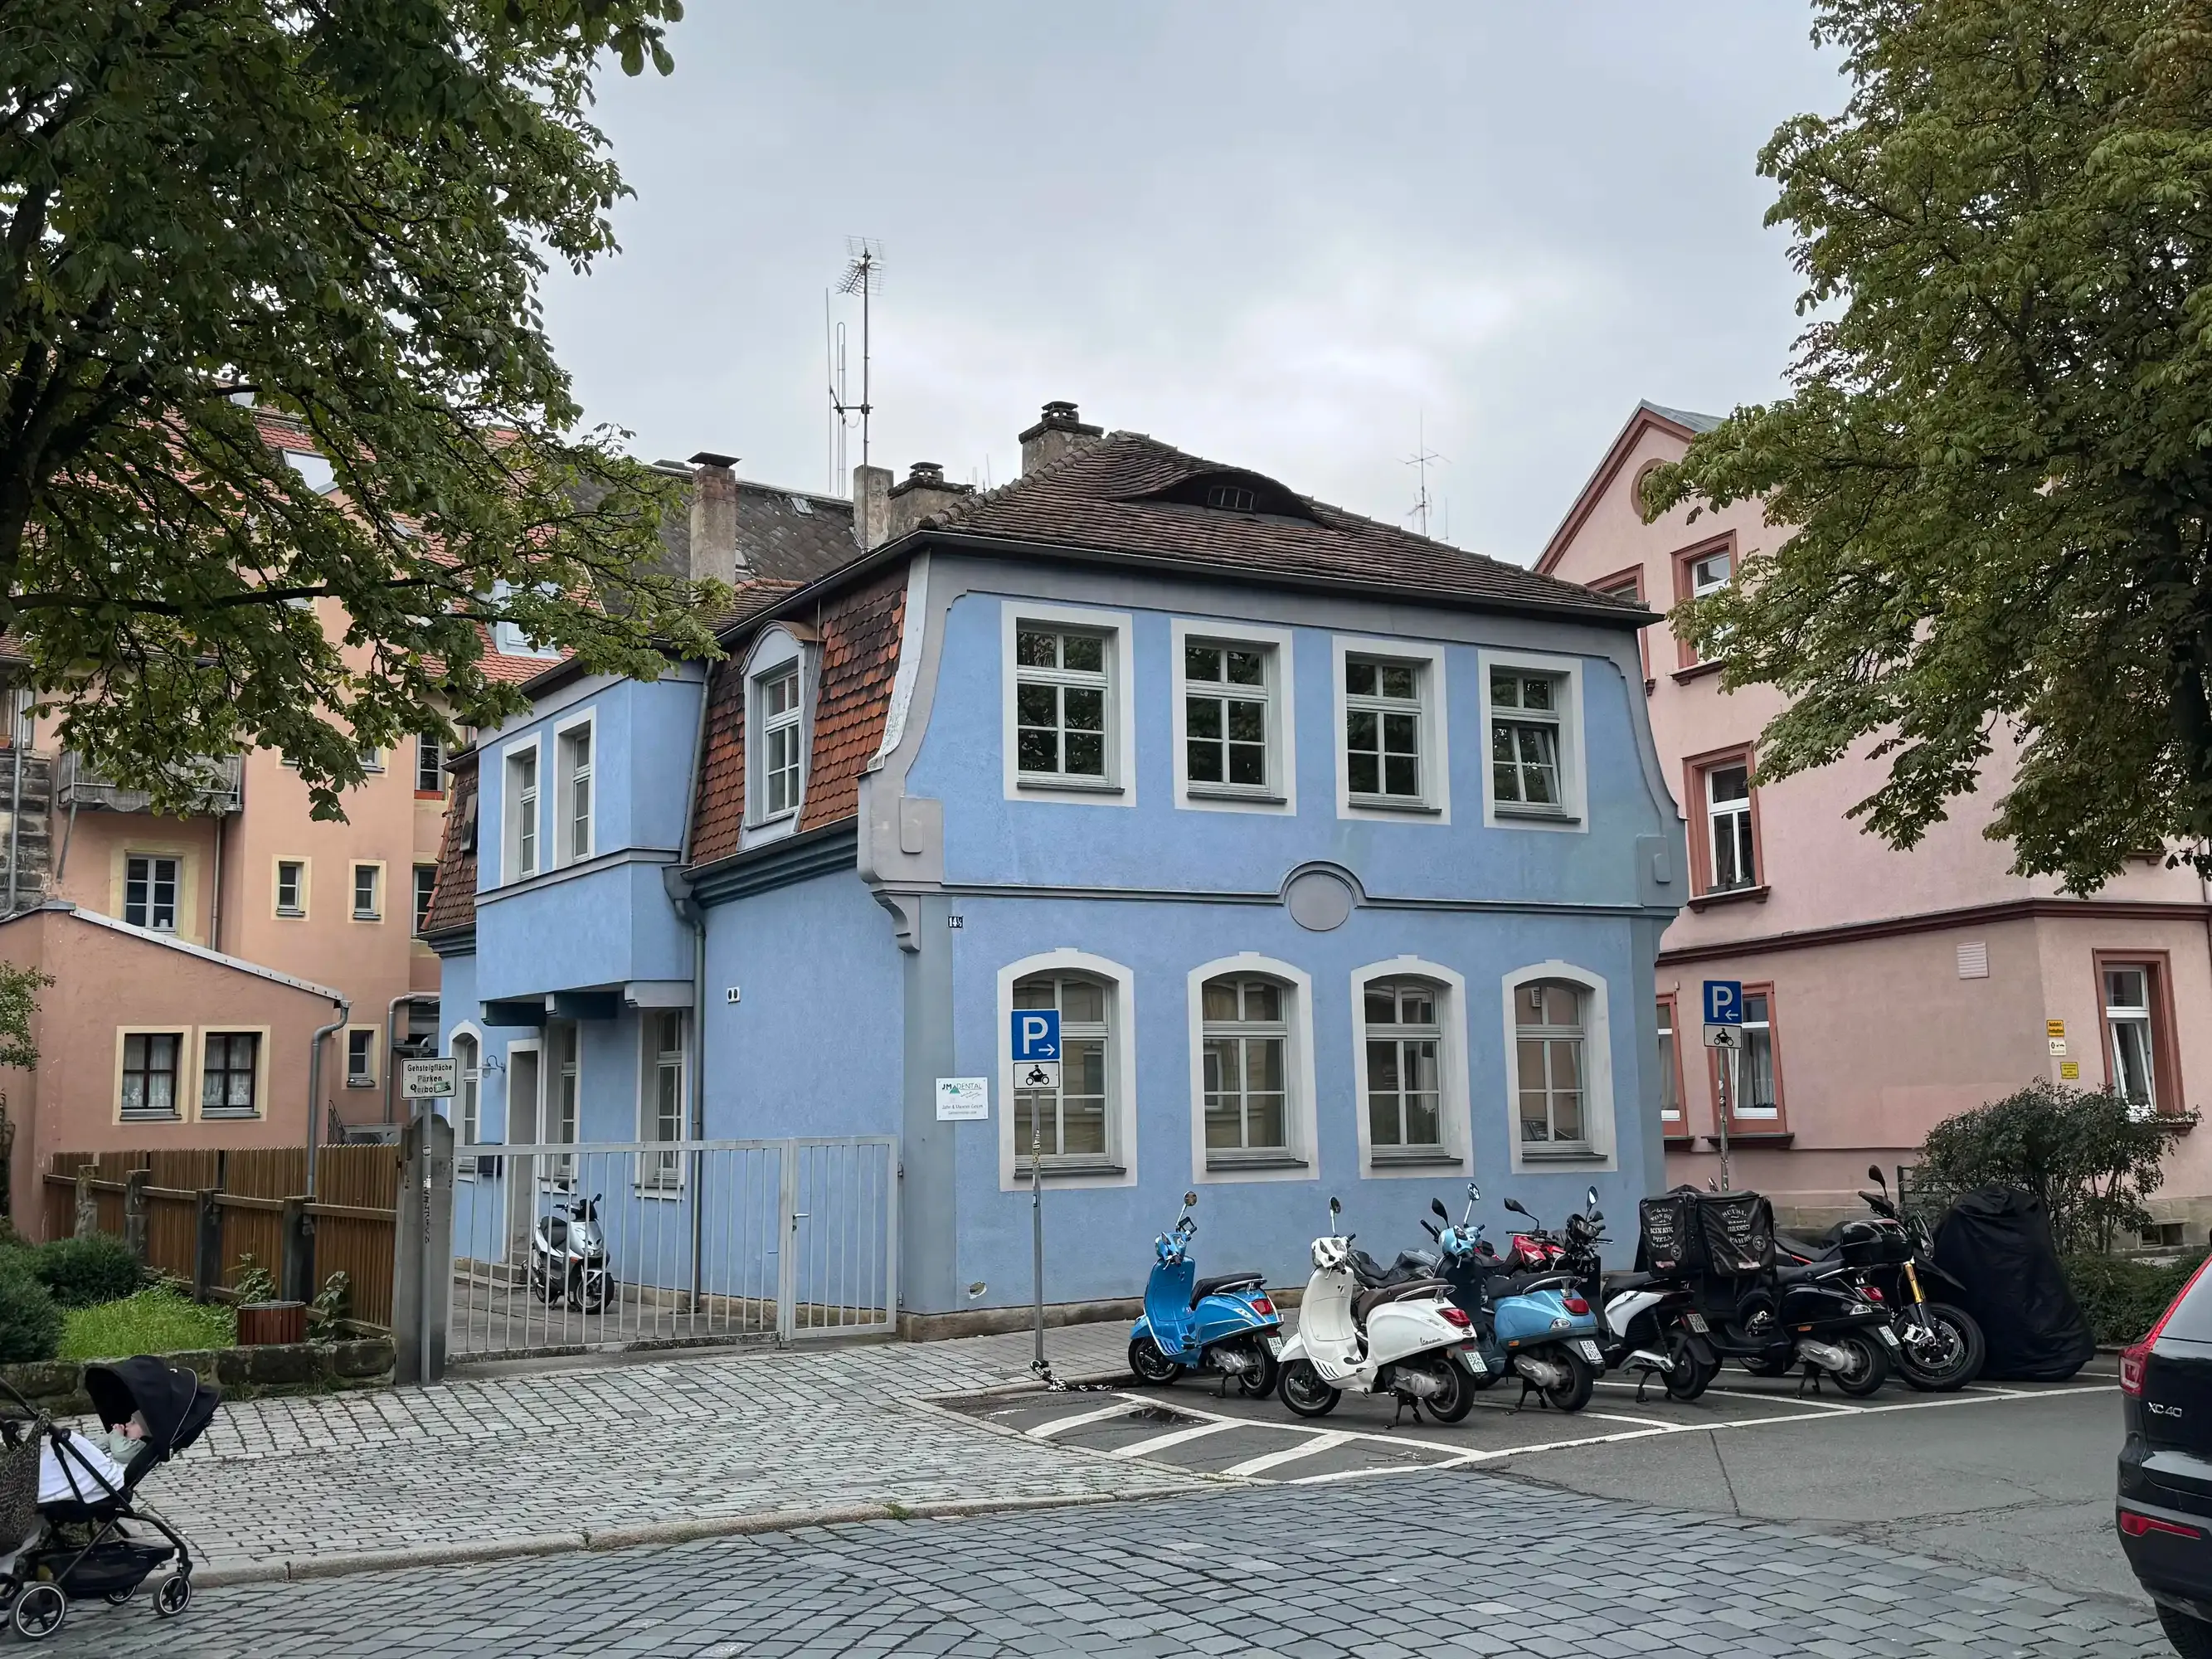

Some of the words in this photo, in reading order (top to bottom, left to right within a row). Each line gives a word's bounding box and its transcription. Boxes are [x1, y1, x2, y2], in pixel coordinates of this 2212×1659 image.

[1712, 985, 1733, 1018] P
[1023, 1016, 1048, 1054] P
[407, 1063, 453, 1073] Gehsteigfläche
[417, 1074, 443, 1082] Parken
[1420, 1337, 1444, 1346] Vespa
[1582, 1340, 1596, 1350] 605
[2148, 1402, 2182, 1418] XC40
